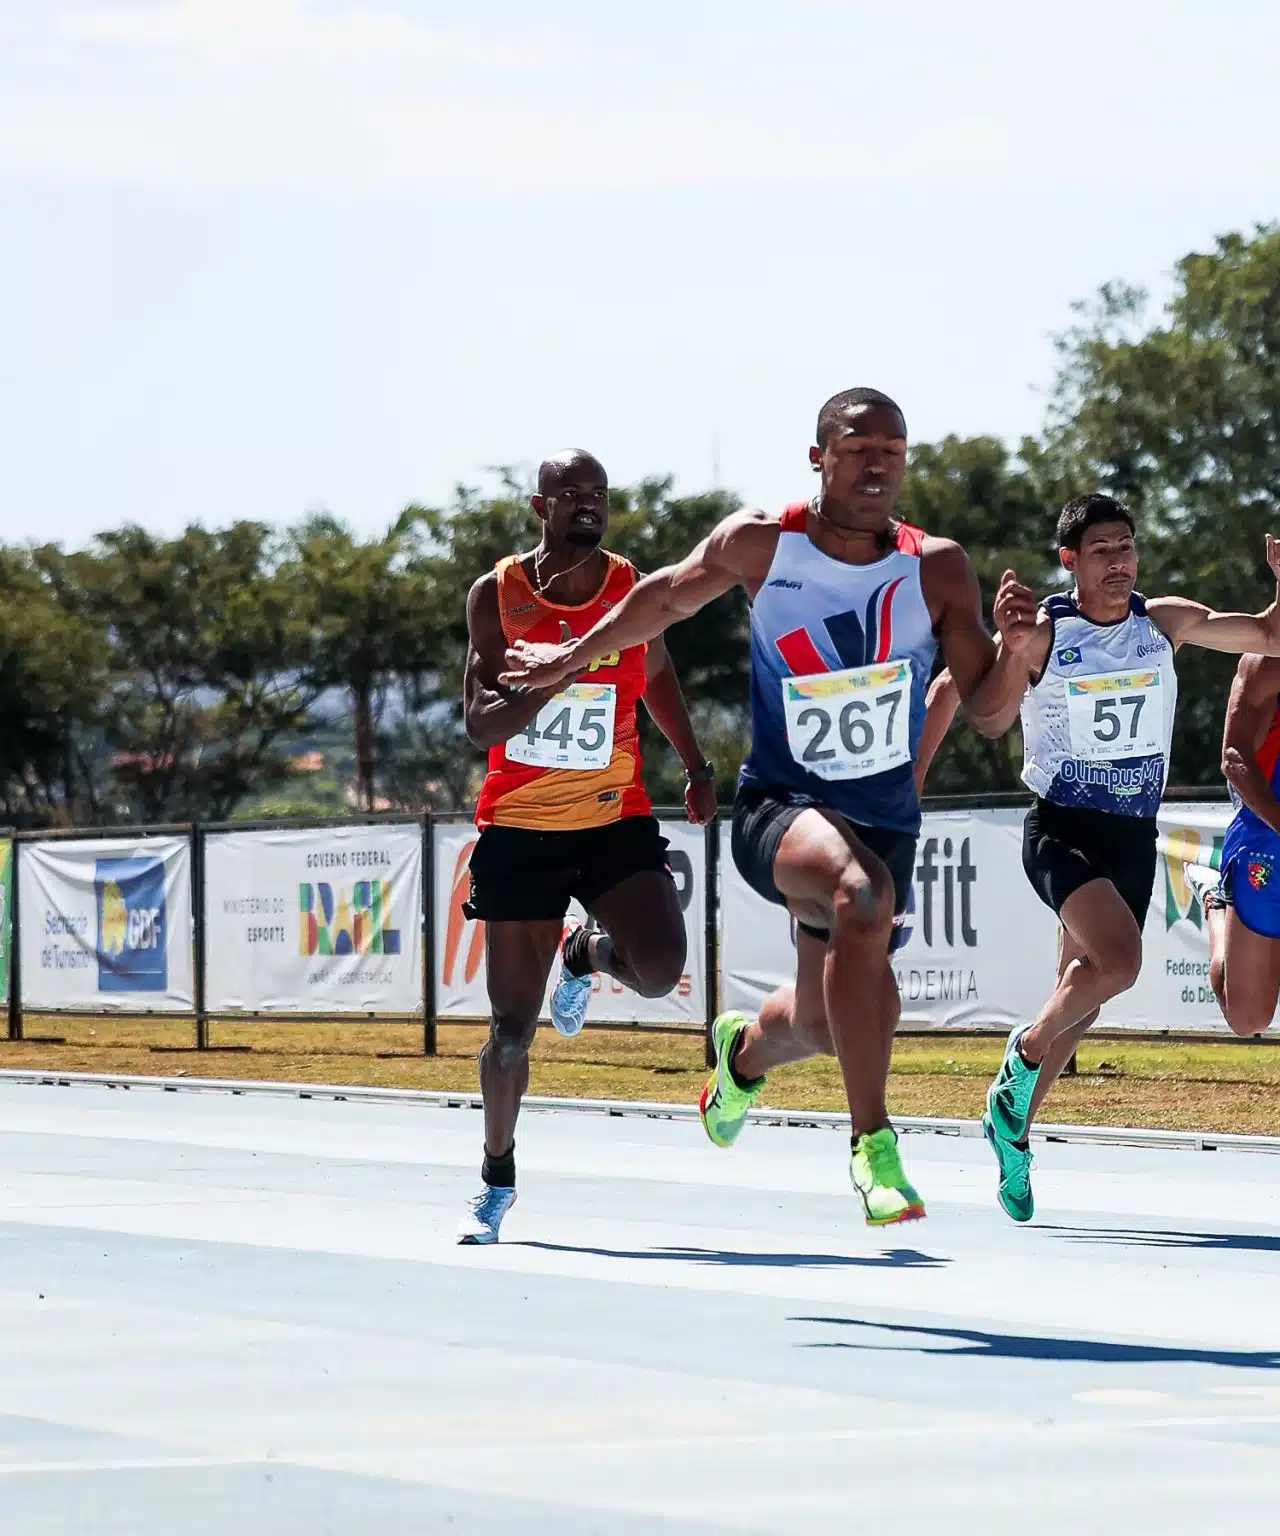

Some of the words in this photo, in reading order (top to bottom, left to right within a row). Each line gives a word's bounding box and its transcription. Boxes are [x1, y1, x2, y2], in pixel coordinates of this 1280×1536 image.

[797, 690, 902, 762] 267
[1093, 695, 1146, 742] 57
[307, 854, 347, 868] GOVERNO
[351, 851, 391, 866] FEDERAL
[893, 837, 978, 949] fit
[128, 908, 161, 950] GDF
[248, 927, 285, 942] ESPORTE
[1166, 959, 1211, 981] Federaç
[1181, 986, 1195, 1002] do
